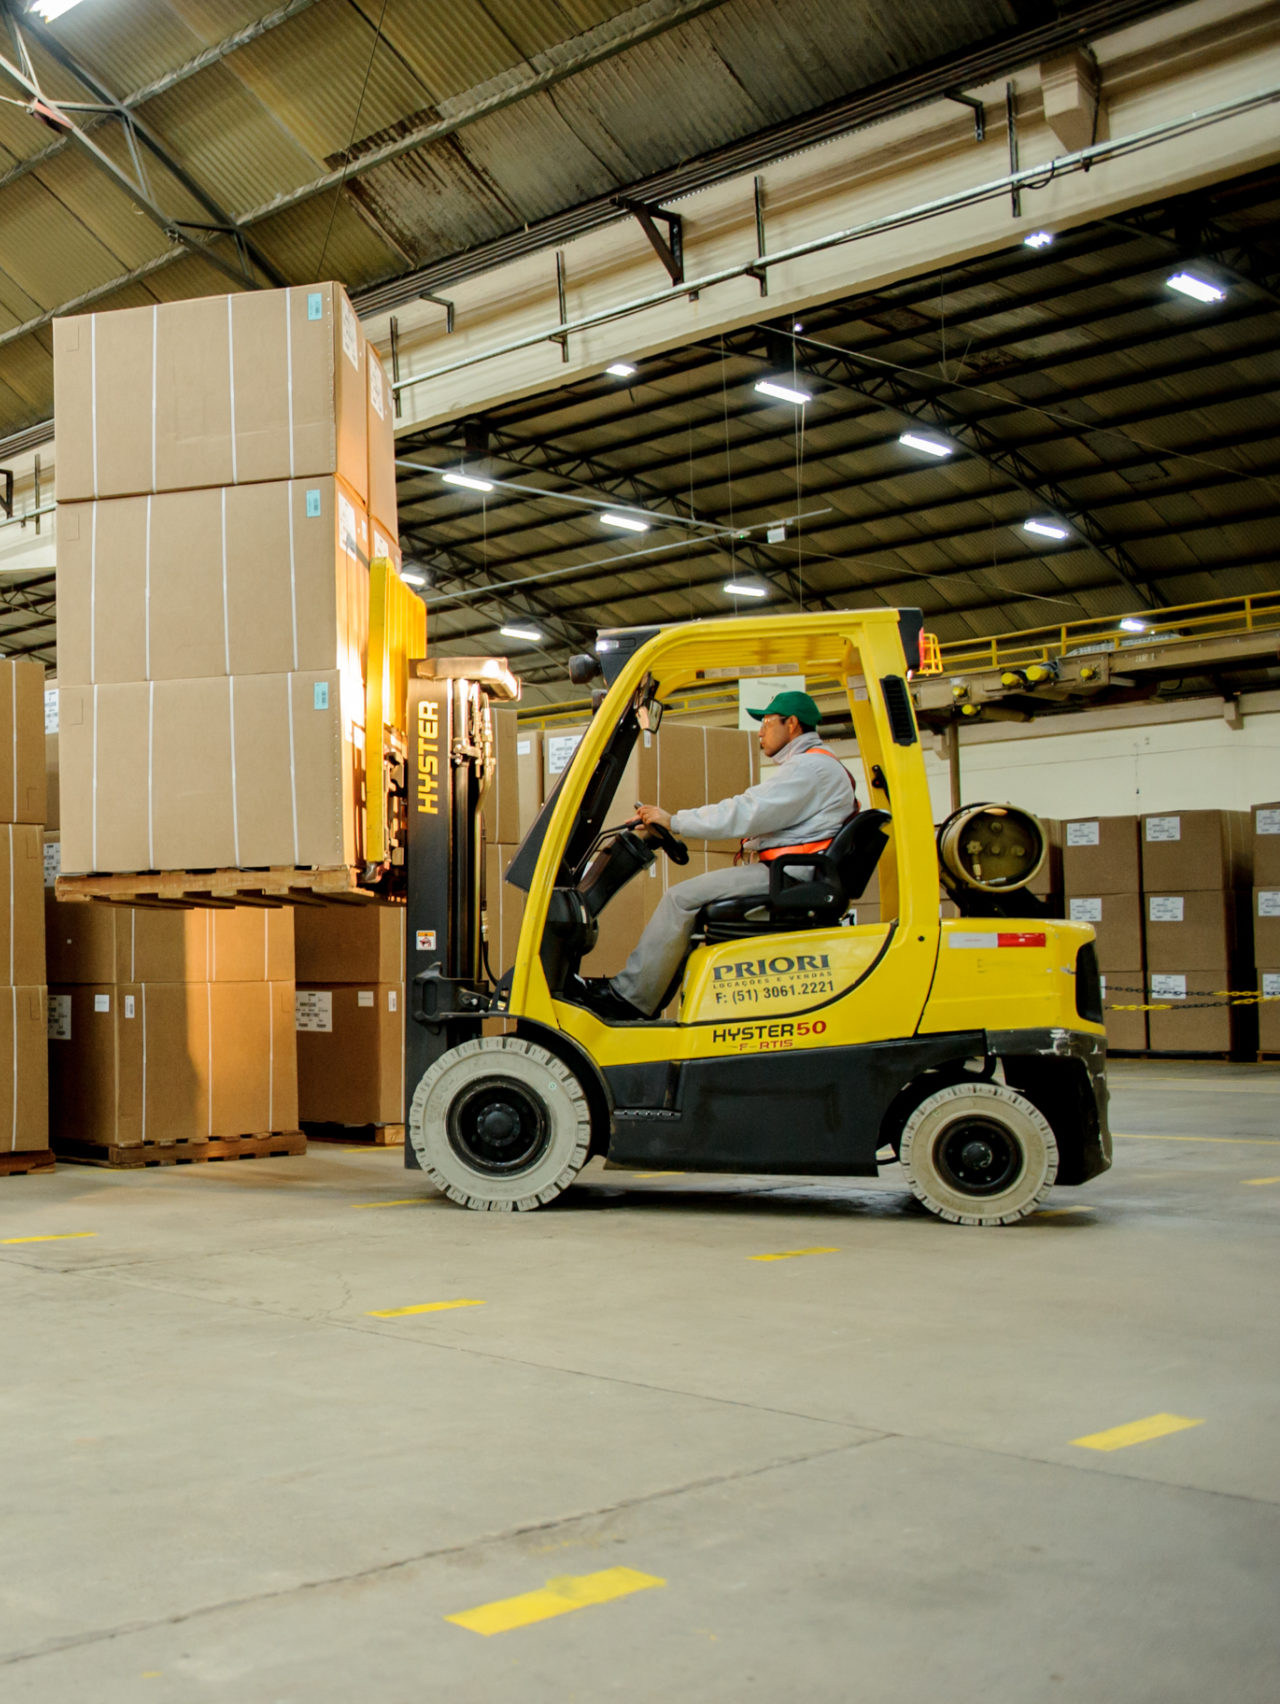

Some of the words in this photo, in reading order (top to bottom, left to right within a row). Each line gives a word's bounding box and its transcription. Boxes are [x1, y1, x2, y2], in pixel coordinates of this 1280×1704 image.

[418, 700, 439, 815] HYSTER
[713, 954, 830, 980] PRIORI
[789, 971, 833, 982] VENDAS
[715, 992, 727, 1005] F:
[732, 988, 758, 1005] (51)
[763, 980, 835, 999] 3061.2221
